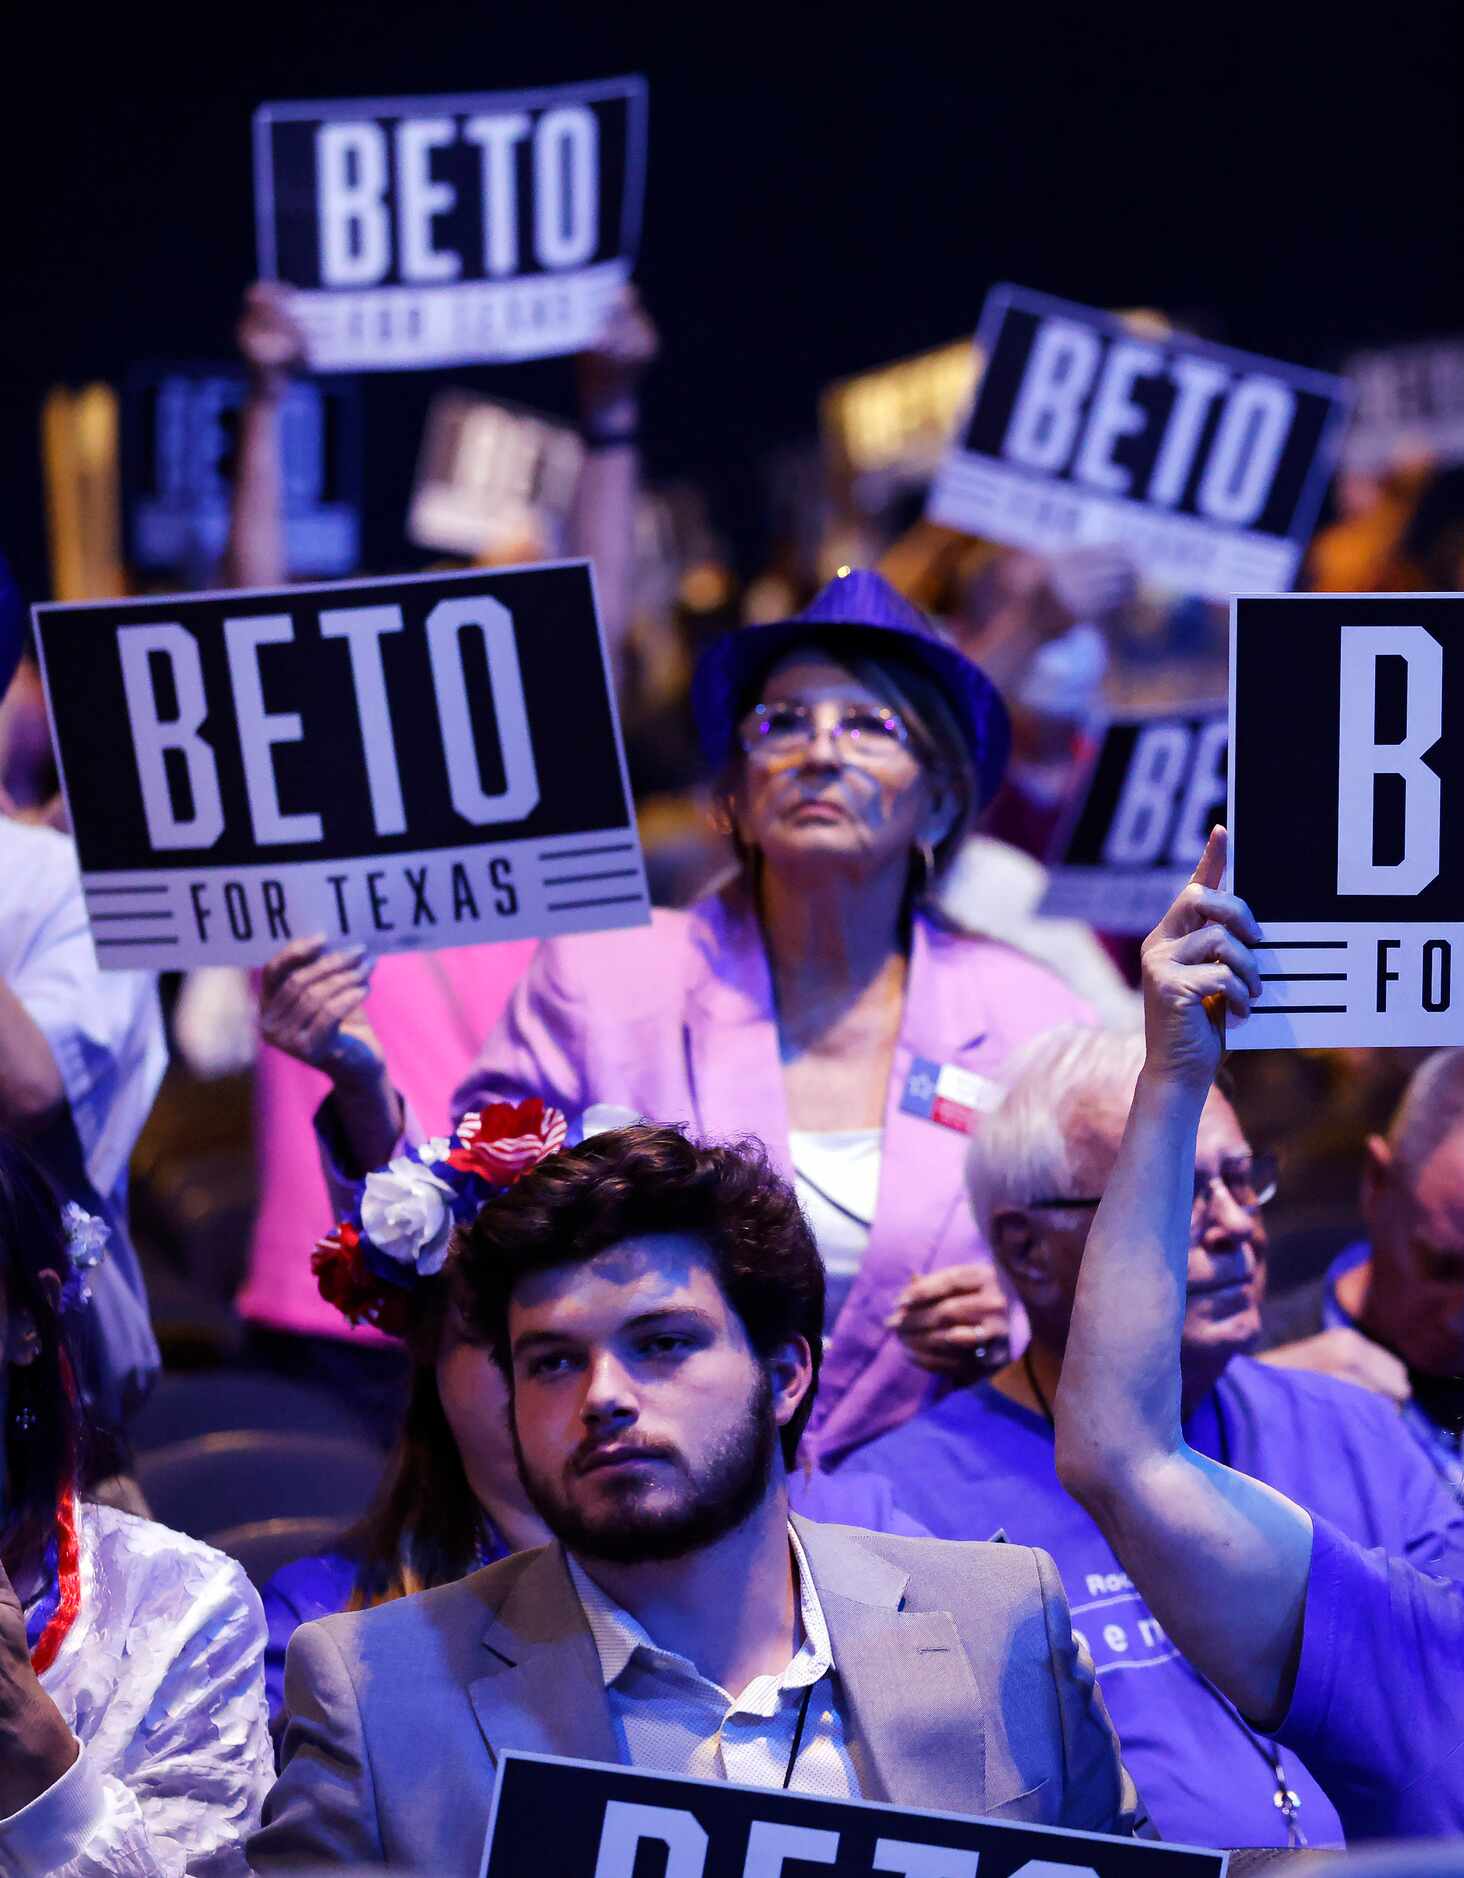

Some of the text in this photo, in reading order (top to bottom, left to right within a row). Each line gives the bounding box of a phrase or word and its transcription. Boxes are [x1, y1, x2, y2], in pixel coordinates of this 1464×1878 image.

[316, 105, 598, 285] BETO
[1004, 318, 1296, 527] BETO
[117, 595, 539, 850] BETO
[190, 857, 521, 942] FOR TEXAS
